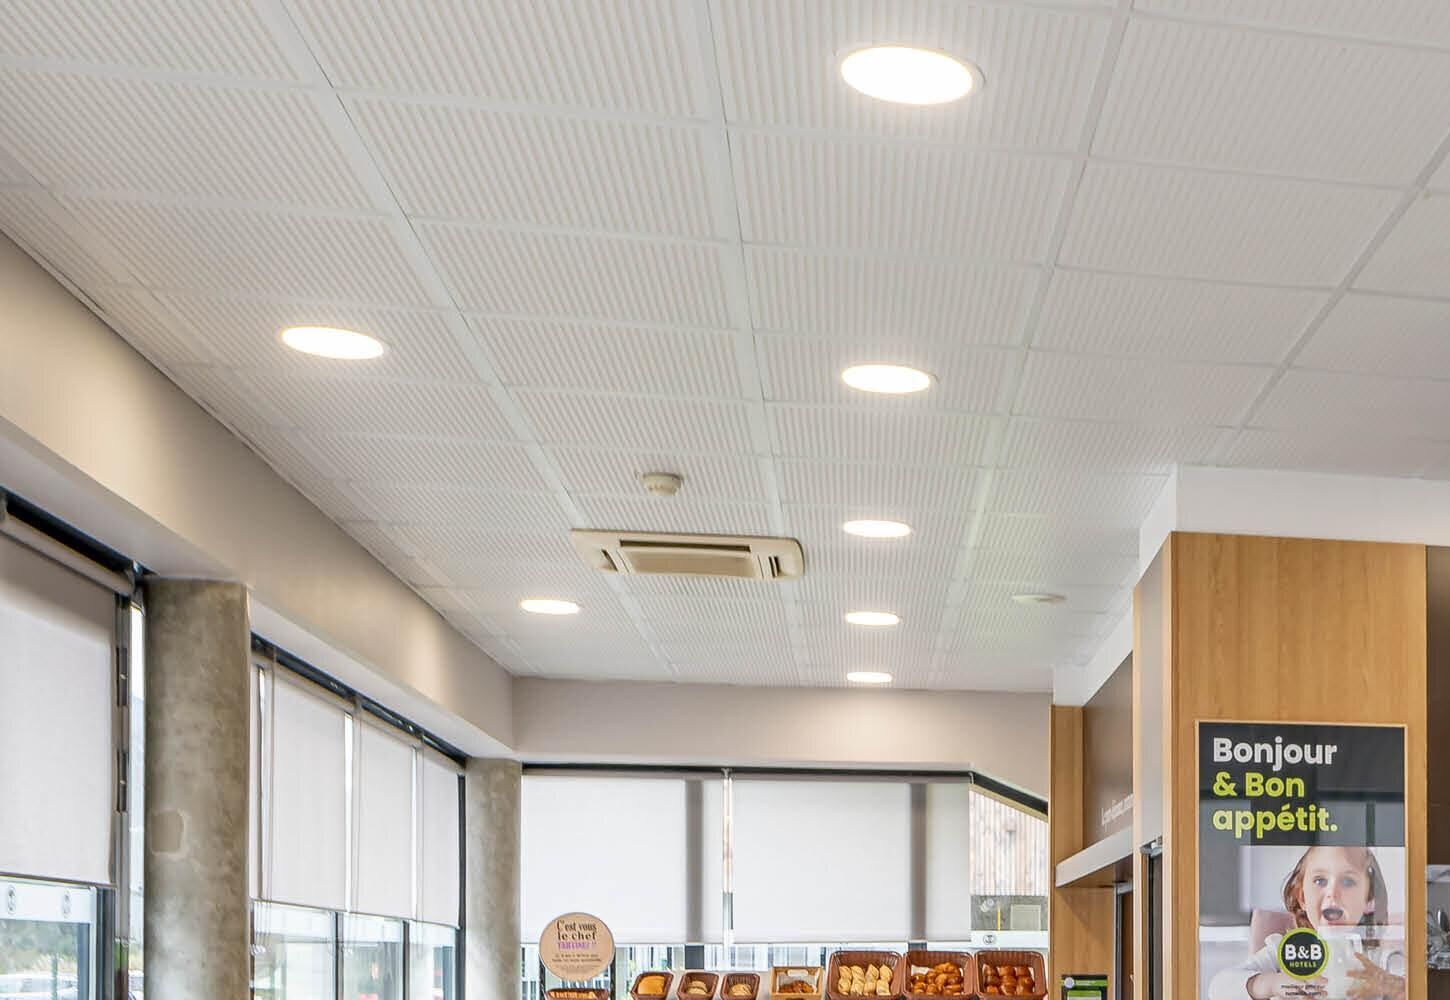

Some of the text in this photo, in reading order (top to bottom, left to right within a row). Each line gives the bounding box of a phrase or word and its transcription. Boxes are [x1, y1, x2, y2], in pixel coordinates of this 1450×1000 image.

[1212, 736, 1338, 771] Bonjour
[1212, 772, 1305, 798] & Bon
[1212, 803, 1338, 838] appétit.
[1284, 943, 1323, 961] B&B
